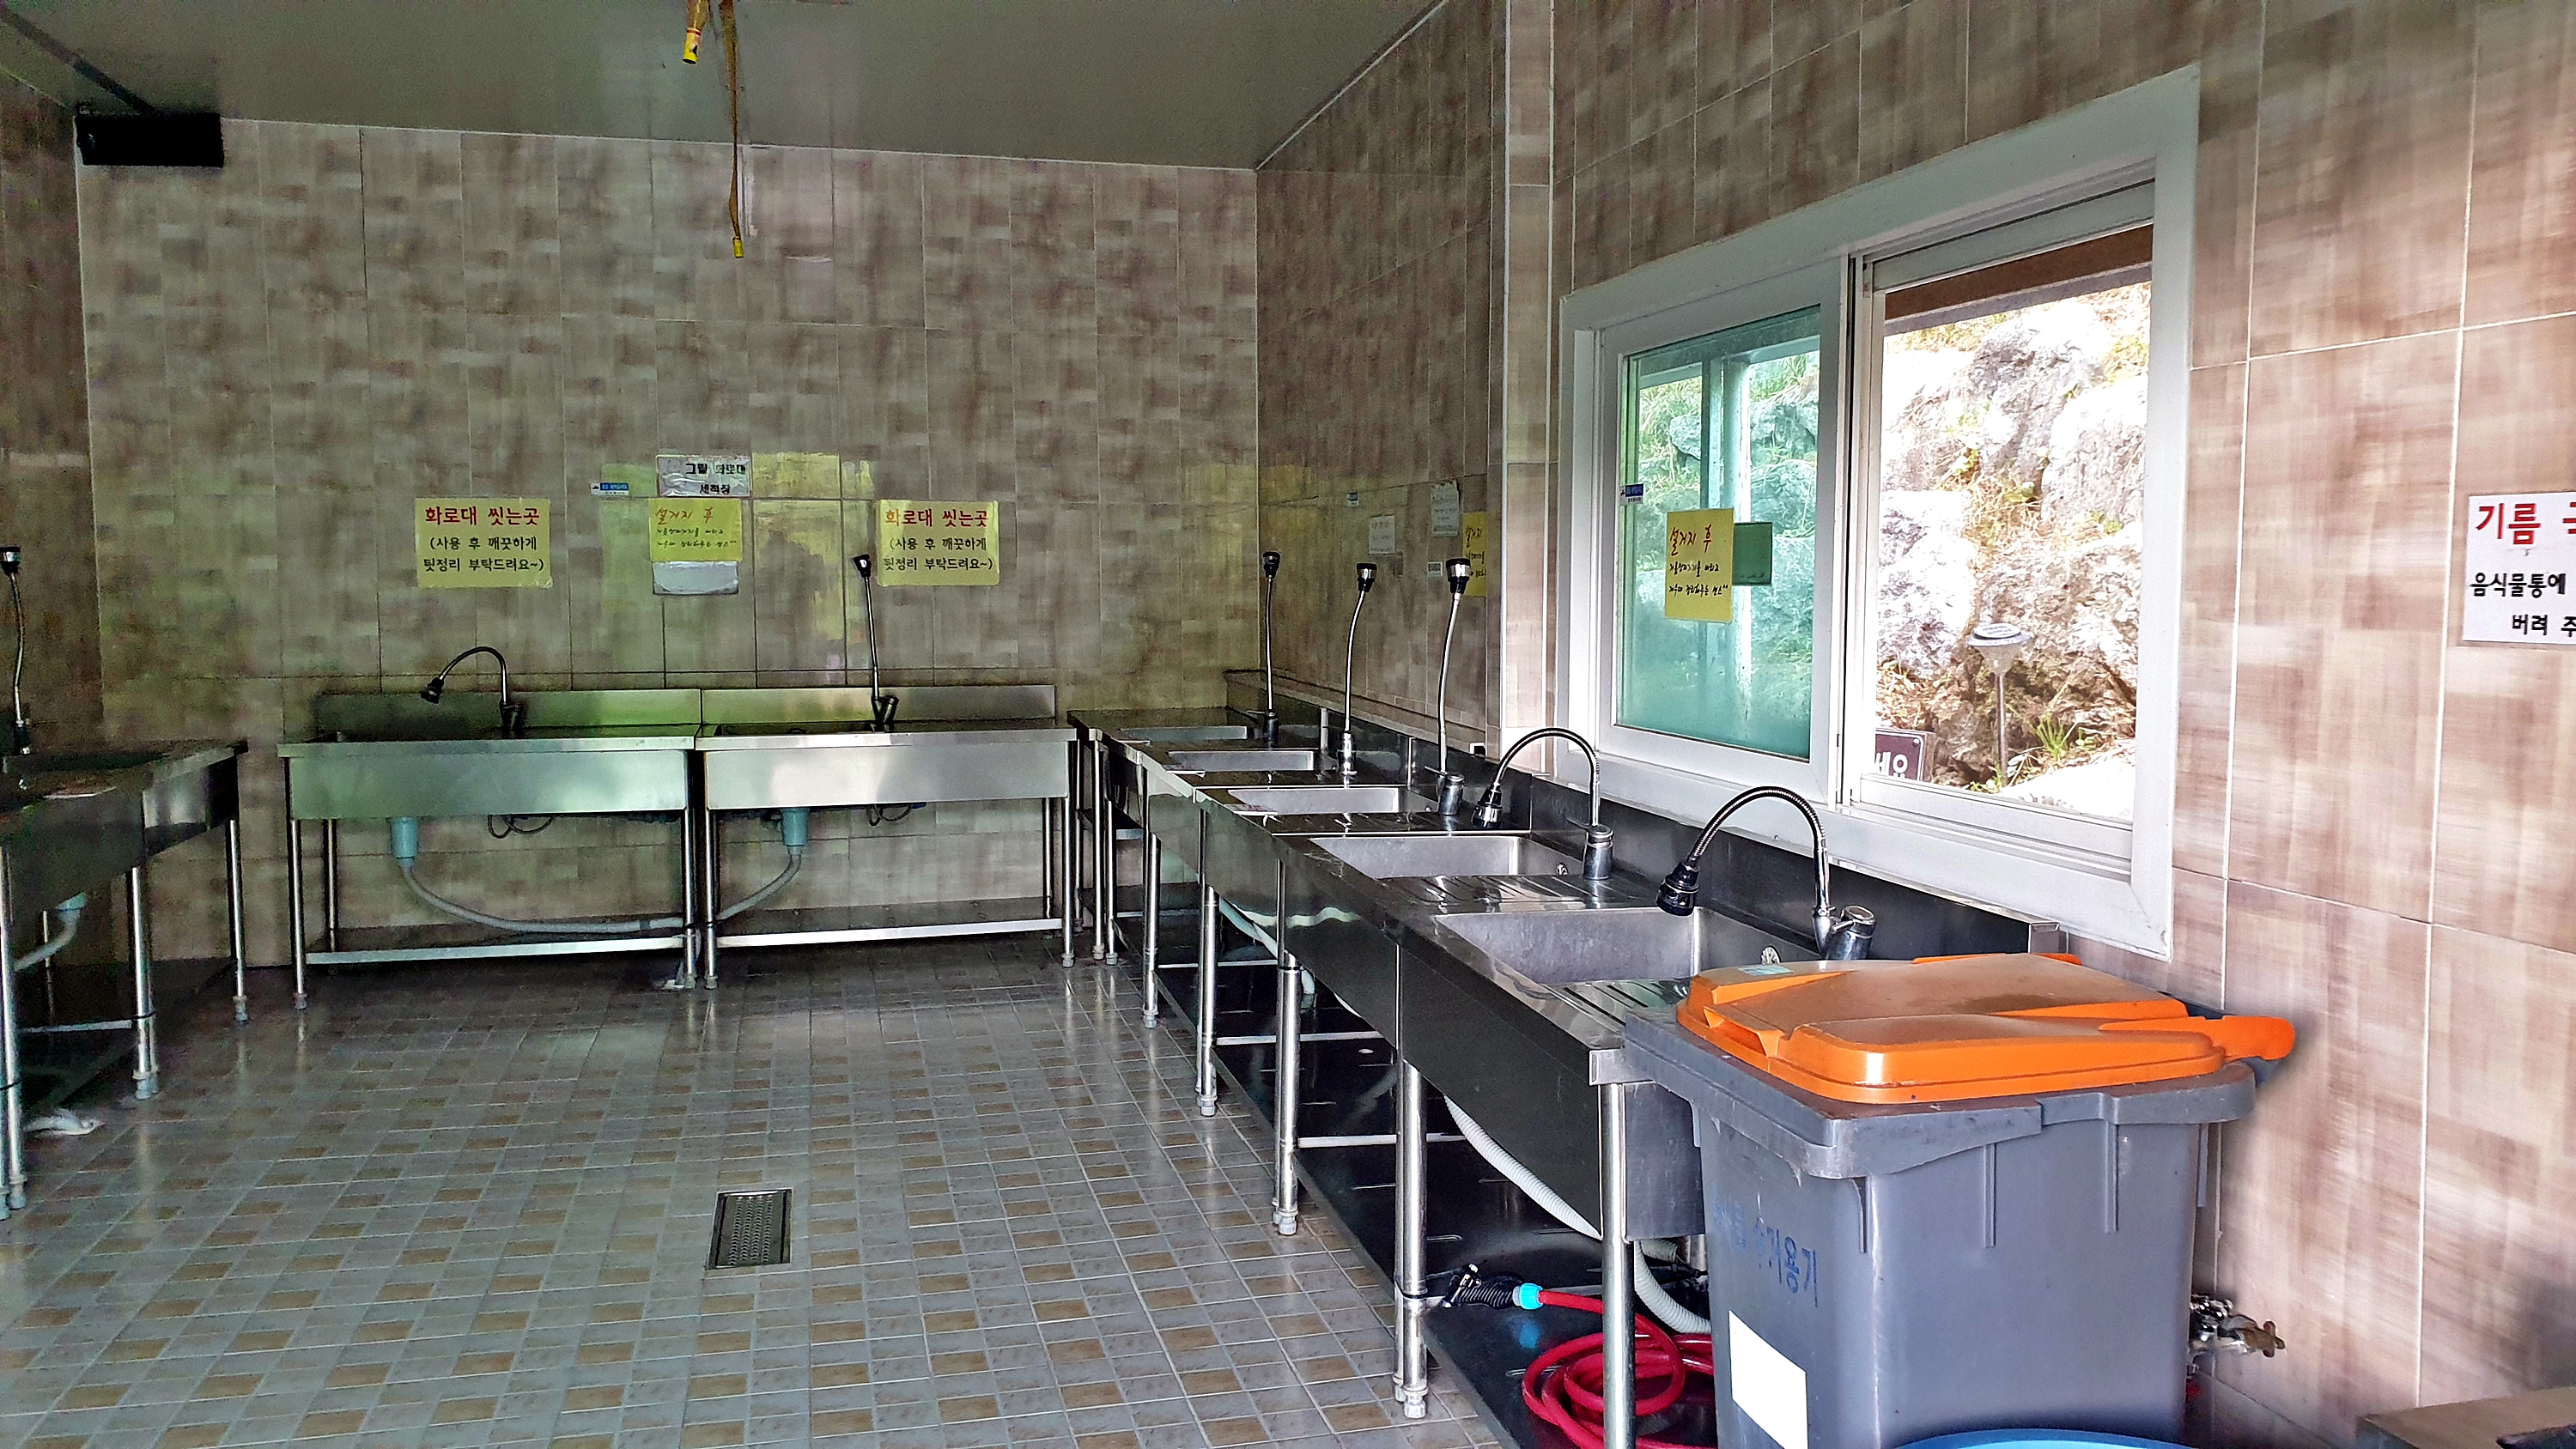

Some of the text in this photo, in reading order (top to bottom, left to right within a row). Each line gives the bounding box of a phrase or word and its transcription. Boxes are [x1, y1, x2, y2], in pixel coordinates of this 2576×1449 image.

[424, 506, 540, 525] 화로대 씻는곳
[885, 508, 989, 527] 화로대 씻는곳
[2476, 502, 2542, 545] 기름
[429, 537, 538, 550] (사용 후 깨끗하게
[890, 537, 987, 550] (사용 후 깨끗하게
[1669, 524, 1713, 556] 설거지 후
[423, 558, 544, 572] 뒷정리 부탁드려요~)
[884, 557, 993, 571] 뒷정리 부탁드려요~)
[2470, 572, 2567, 598] 음식물통에
[2512, 614, 2549, 636] 버려
